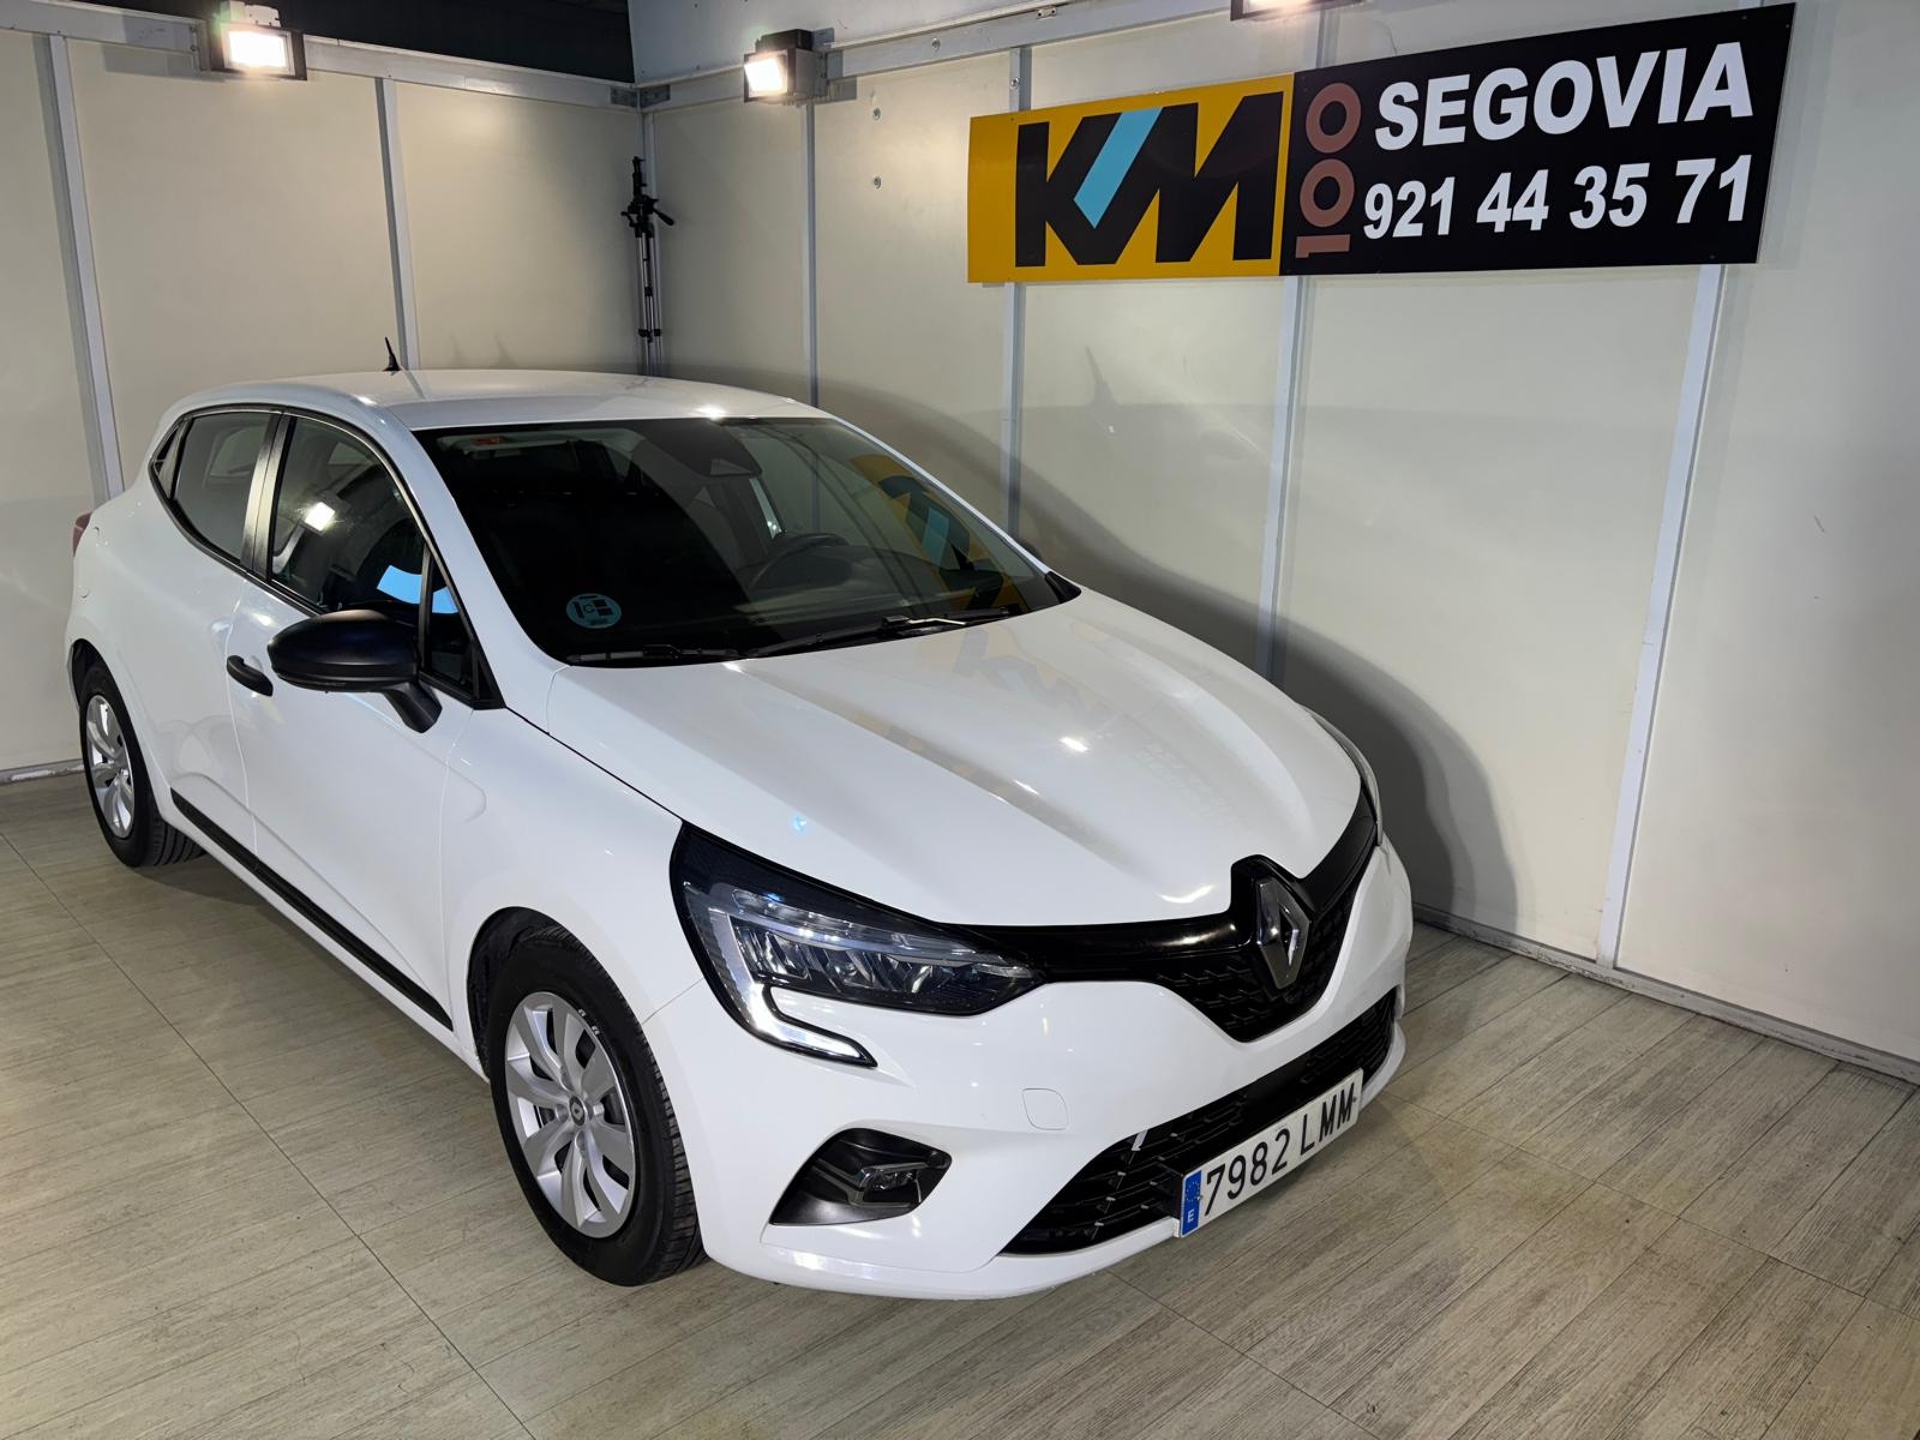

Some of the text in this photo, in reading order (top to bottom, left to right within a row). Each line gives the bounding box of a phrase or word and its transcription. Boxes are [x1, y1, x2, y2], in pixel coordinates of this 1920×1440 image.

[1375, 42, 1754, 151] SEGOVIA
[1016, 92, 1284, 267] KM
[1295, 83, 1361, 259] 100
[1364, 155, 1753, 240] 921 44 35 71
[1205, 1082, 1355, 1217] 7982 LMM
[1187, 1209, 1195, 1223] E
